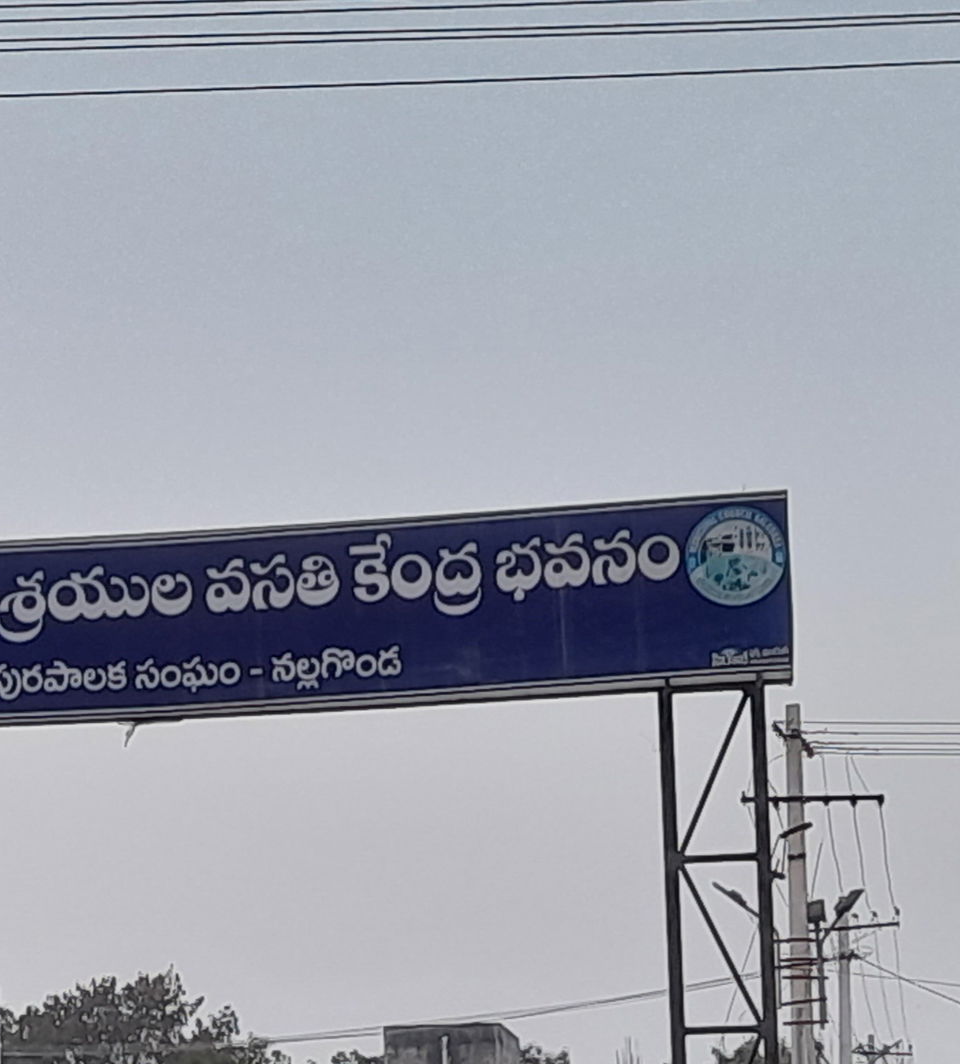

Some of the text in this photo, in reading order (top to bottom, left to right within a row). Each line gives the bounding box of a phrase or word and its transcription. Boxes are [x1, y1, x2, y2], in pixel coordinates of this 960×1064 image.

[205, 554, 340, 613] వసతి
[349, 533, 482, 616] కేంద్ర
[496, 529, 680, 602] భవనం
[135, 656, 240, 694] సంఘం
[271, 645, 401, 688] నల్లగొండ
